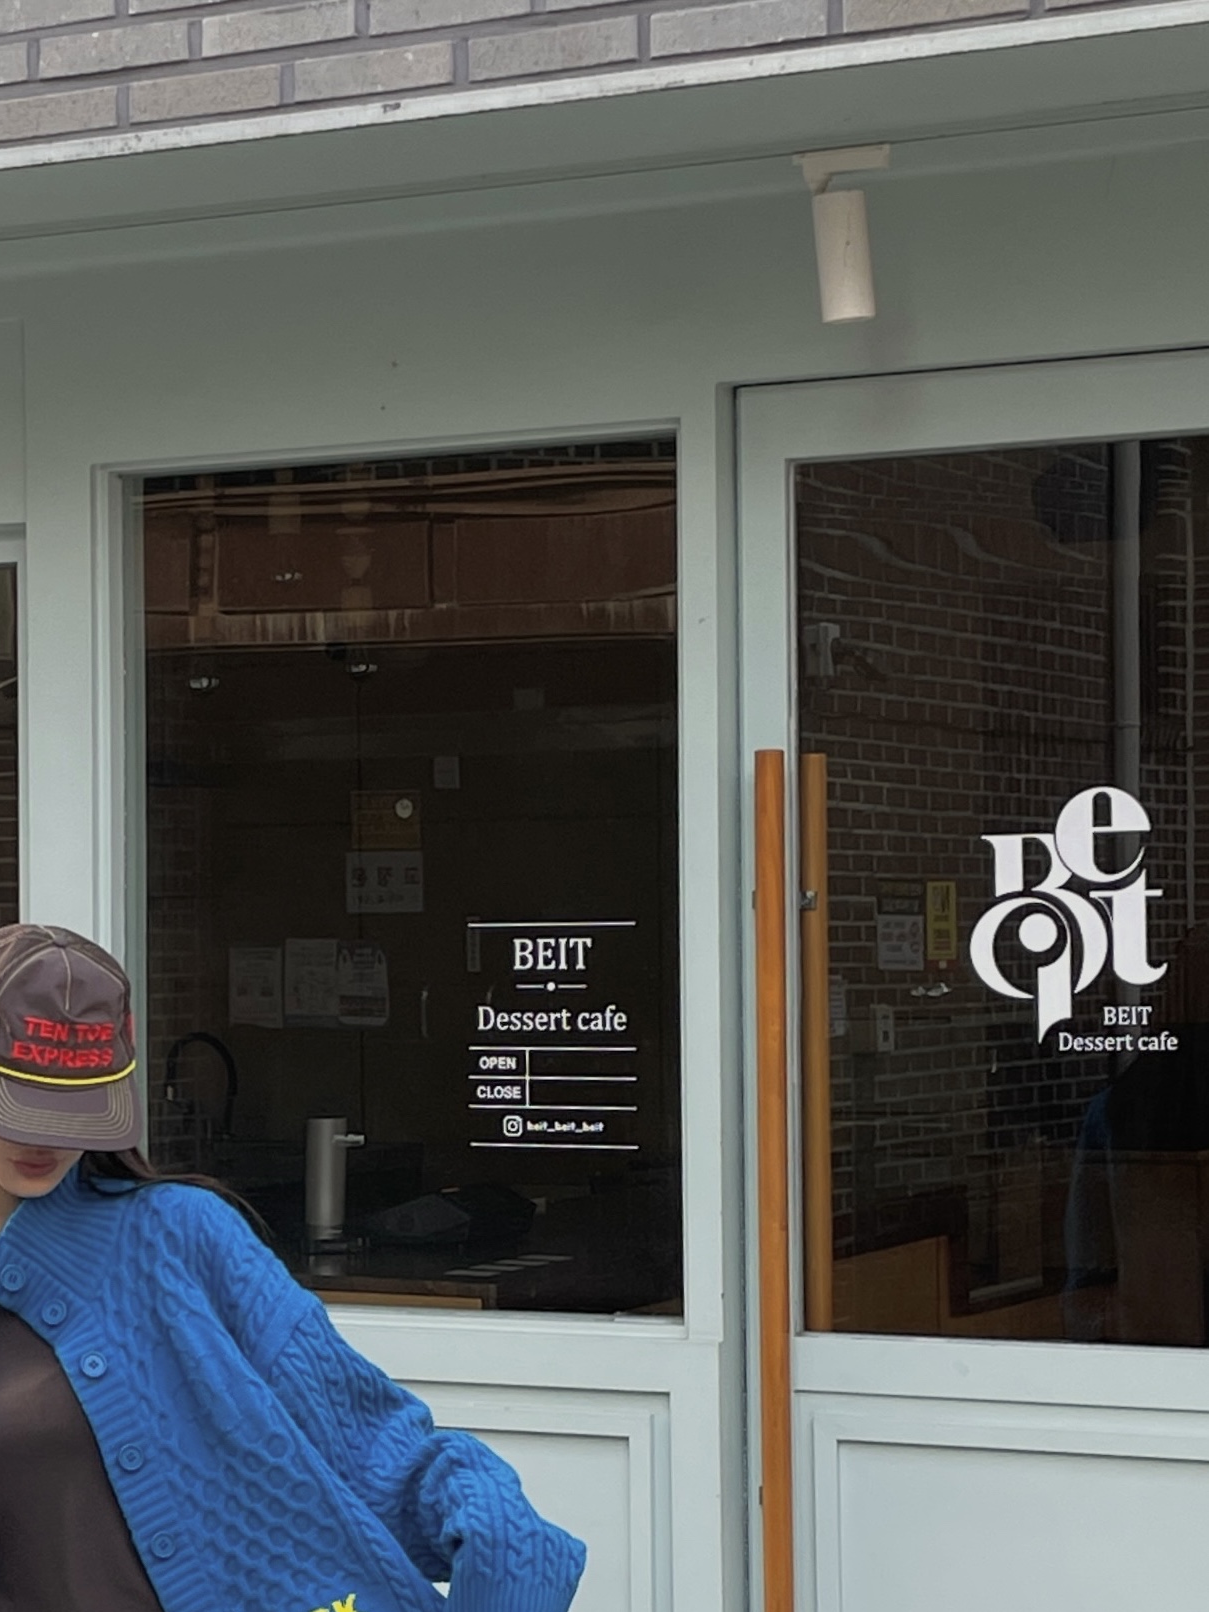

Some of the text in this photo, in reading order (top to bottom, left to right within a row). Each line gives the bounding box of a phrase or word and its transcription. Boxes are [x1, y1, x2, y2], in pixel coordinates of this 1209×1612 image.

[512, 937, 593, 970] BEIT
[476, 1004, 628, 1031] Dessert cafe
[1102, 1005, 1153, 1026] BEIT
[23, 1015, 115, 1043] TEN TOE
[1057, 1031, 1179, 1052] Dessert cafe
[11, 1041, 114, 1069] EXPRESS
[478, 1056, 517, 1070] OPEN
[476, 1085, 522, 1099] CLOSE
